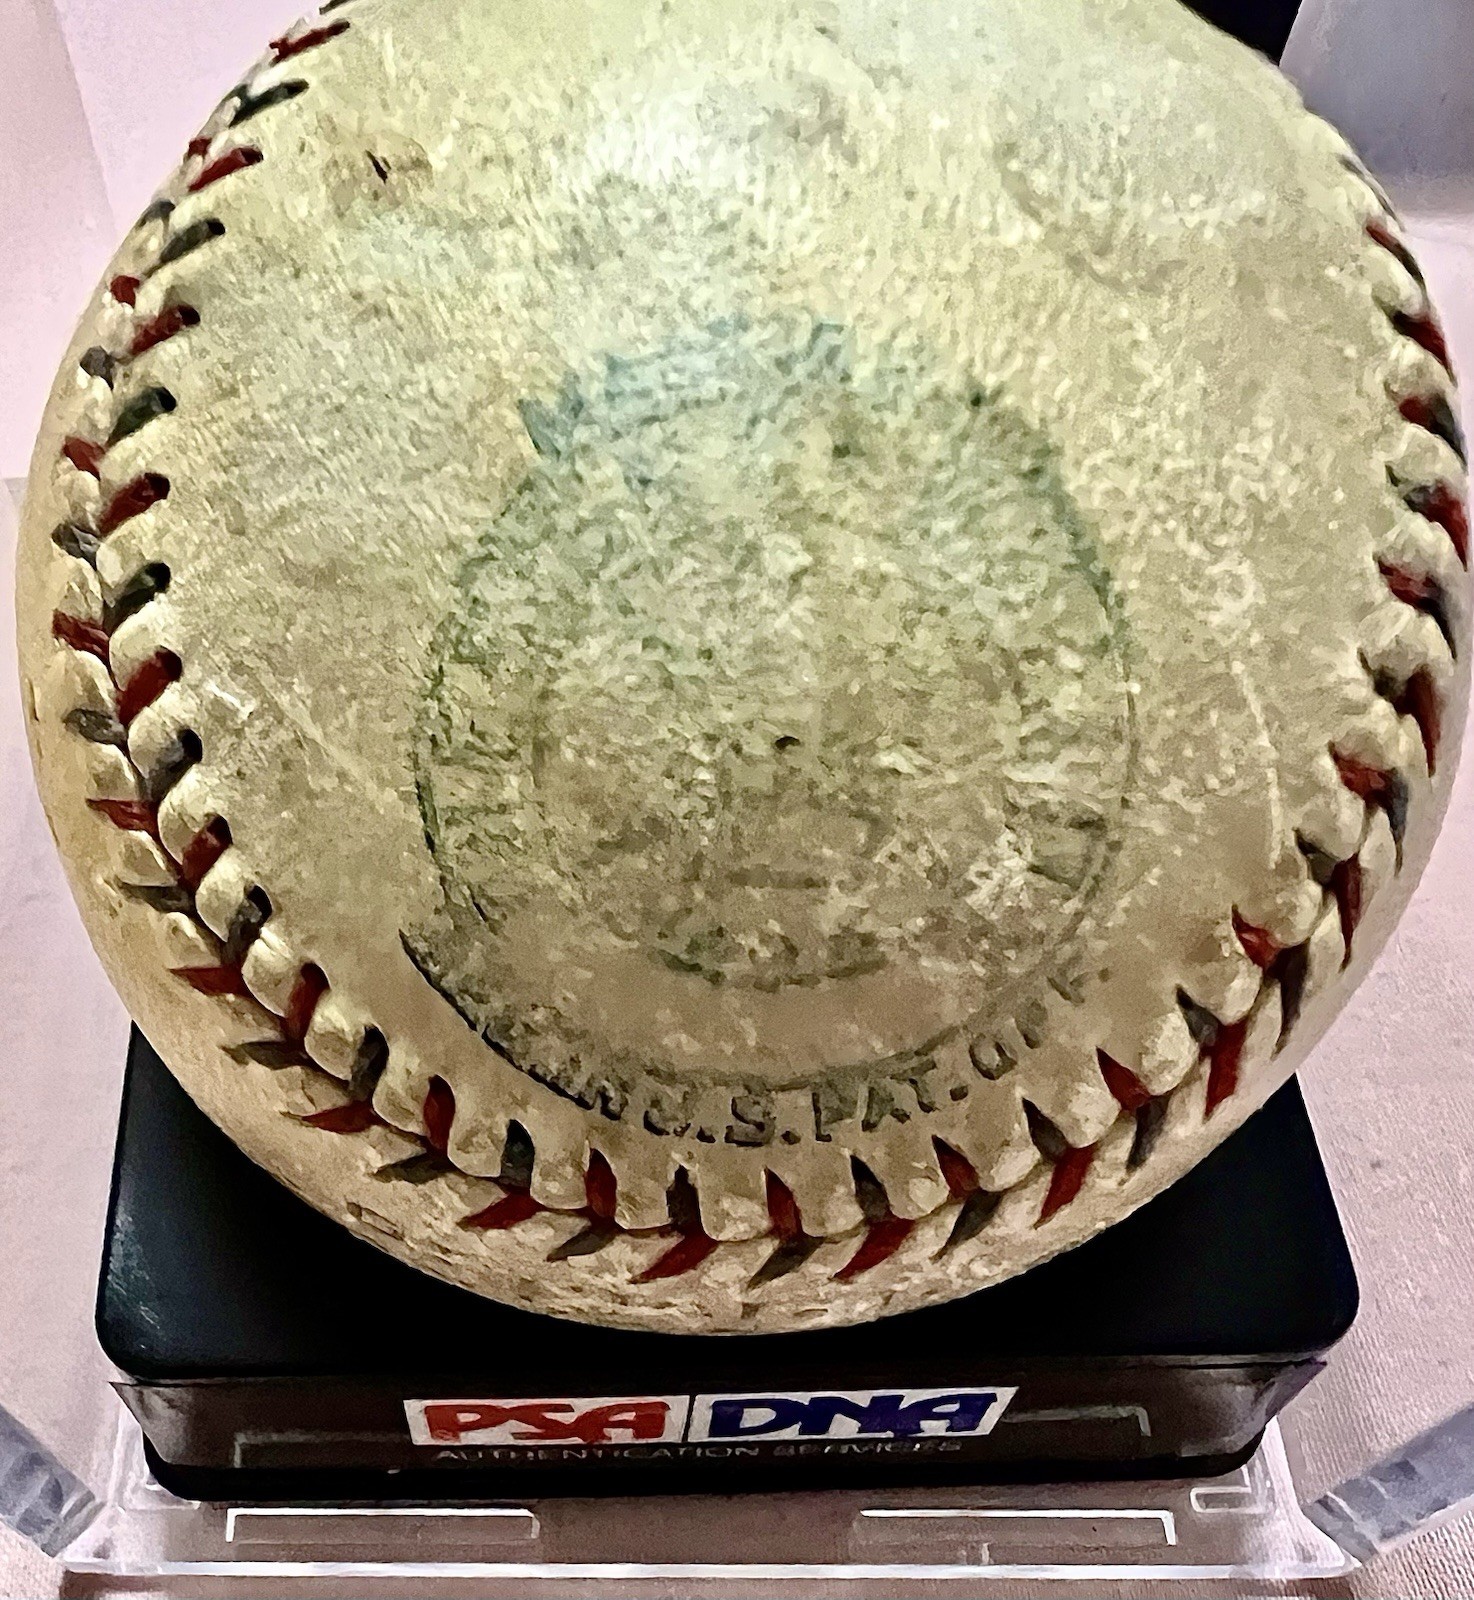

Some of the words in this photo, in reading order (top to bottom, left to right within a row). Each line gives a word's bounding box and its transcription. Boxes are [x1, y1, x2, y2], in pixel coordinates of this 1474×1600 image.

[424, 1401, 671, 1444] PSA
[707, 1391, 998, 1440] DNA
[436, 1447, 760, 1461] AUTHENTICATION
